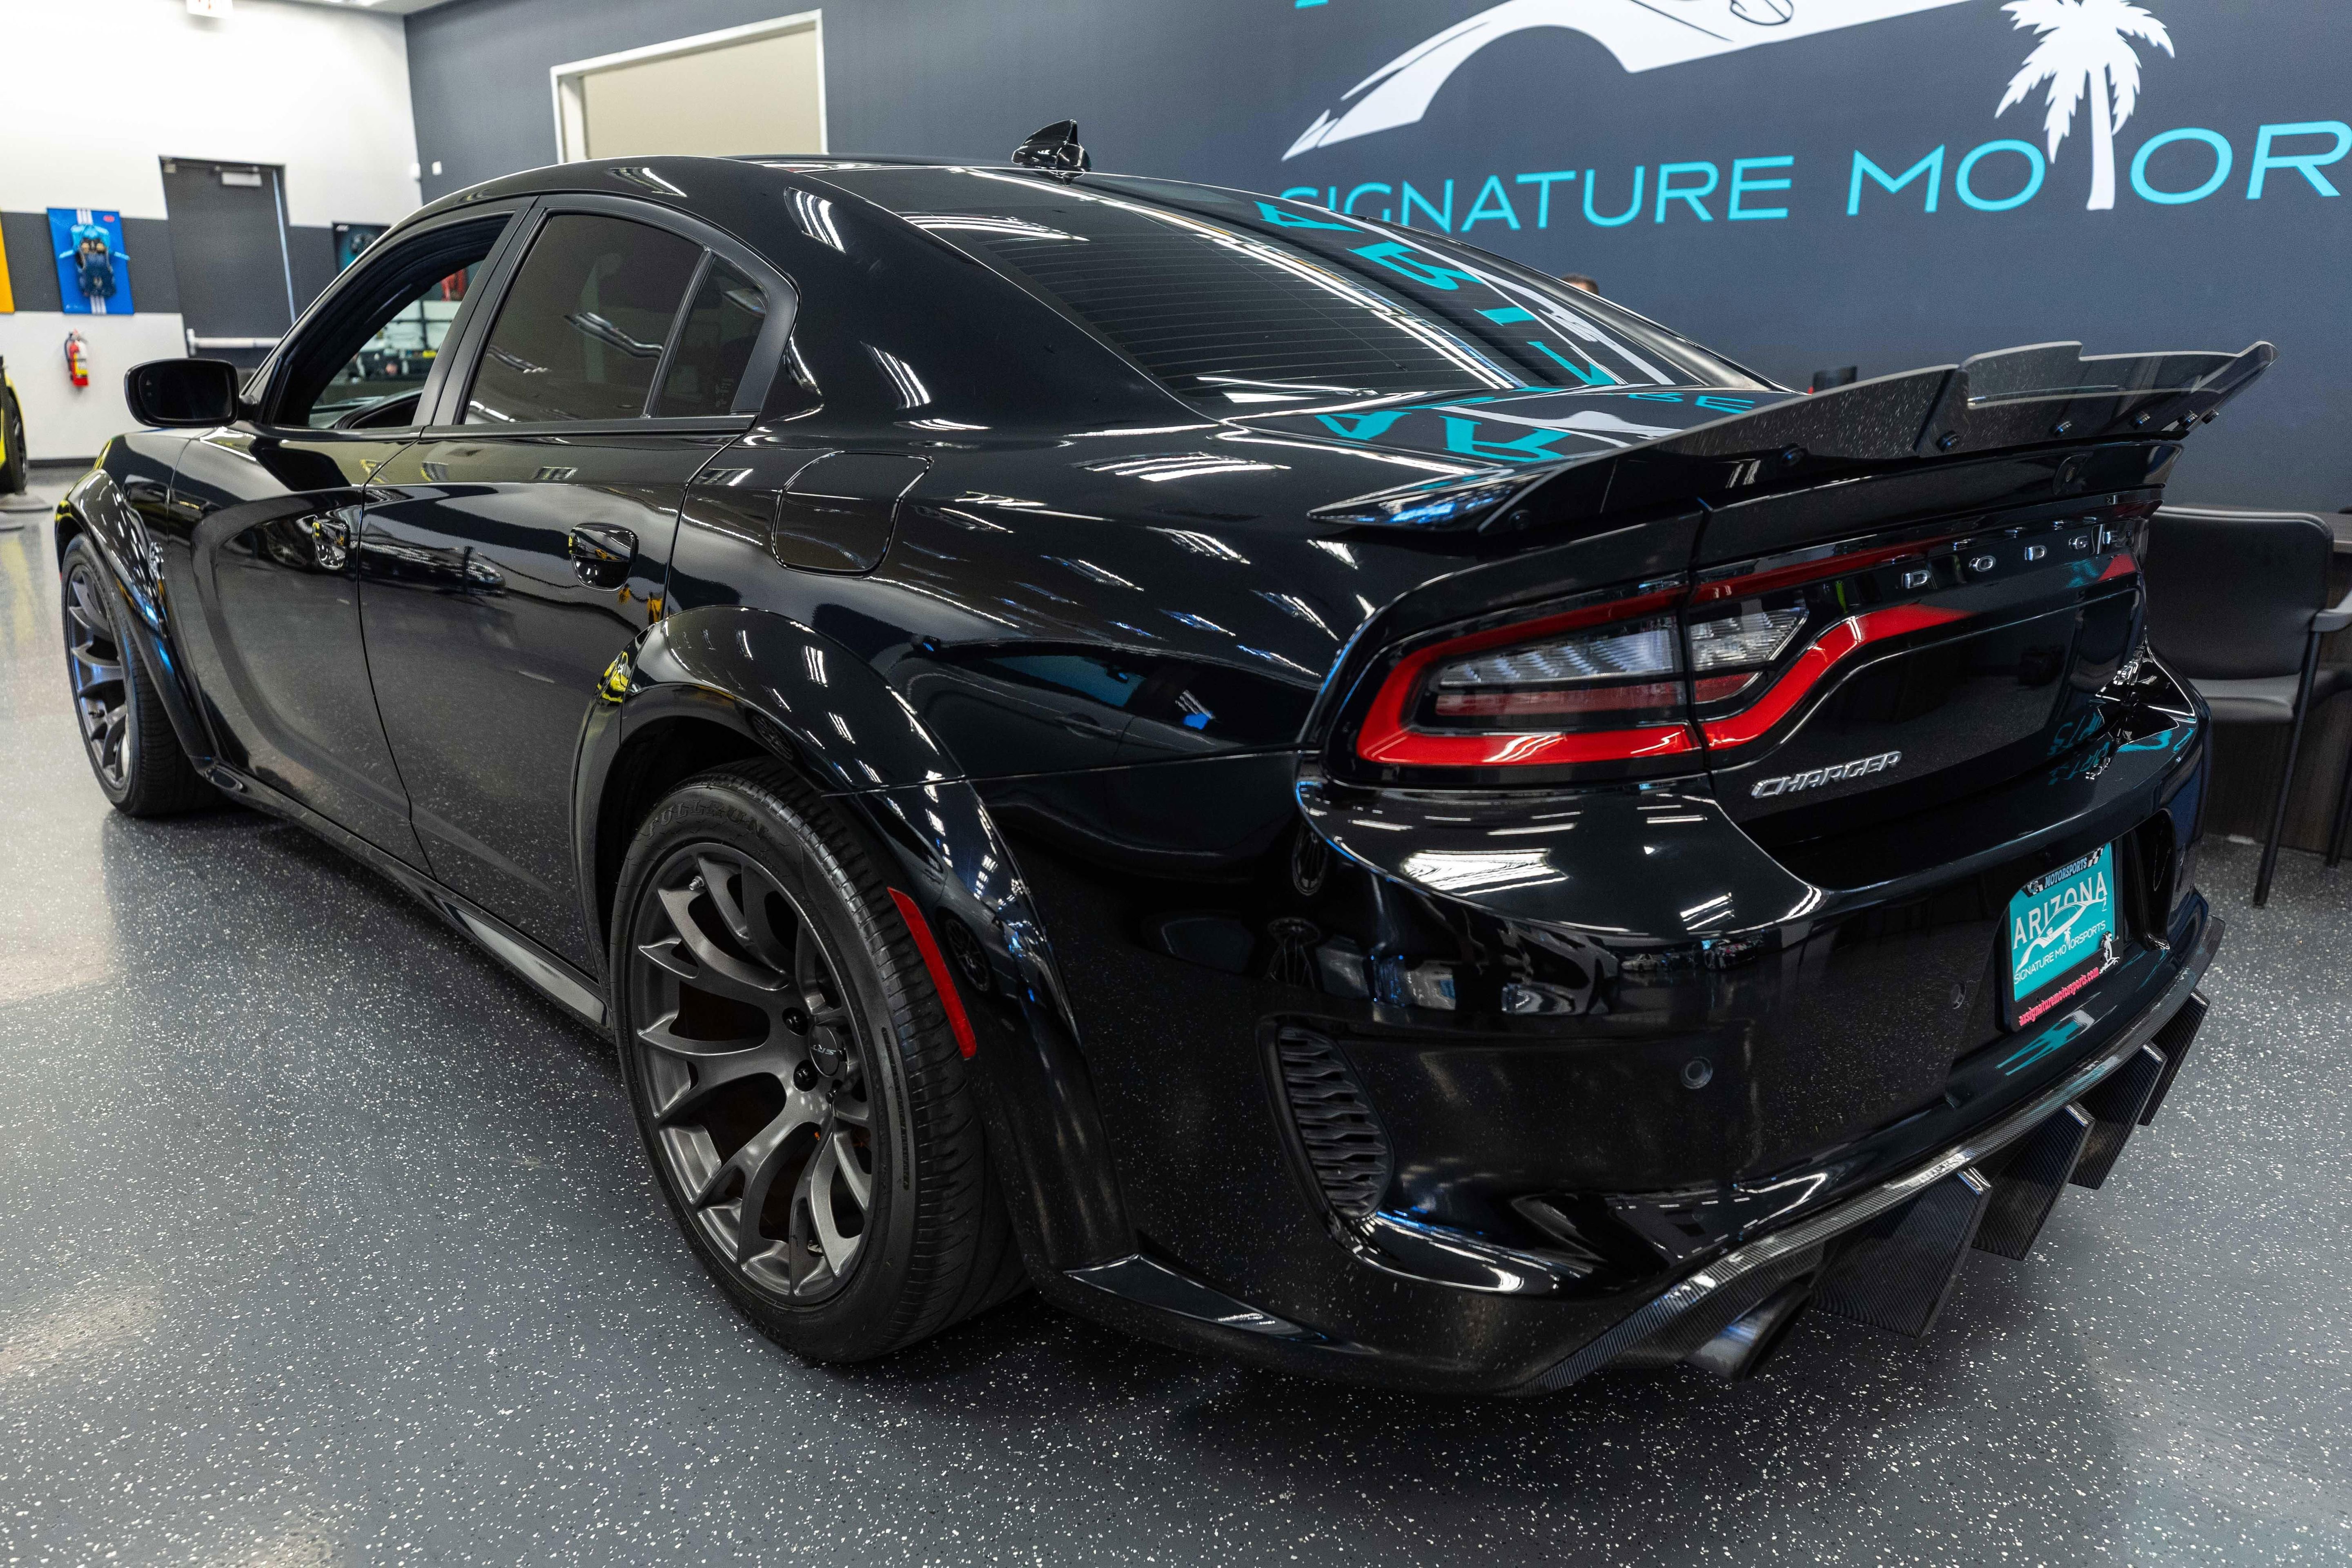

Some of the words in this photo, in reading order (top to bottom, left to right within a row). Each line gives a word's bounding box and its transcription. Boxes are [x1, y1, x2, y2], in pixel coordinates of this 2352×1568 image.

[1901, 531, 2118, 589] DODGE
[1751, 751, 1902, 799] CHARGER
[649, 799, 770, 840] FULLRUN
[2045, 857, 2087, 889] MOTORSPORTS
[2013, 871, 2108, 950] ARIZONA
[2014, 951, 2055, 985] SIGNATURE
[2055, 920, 2106, 959] MOTORSPORTS
[2018, 967, 2100, 1027] azsignaturemotorsports.com
